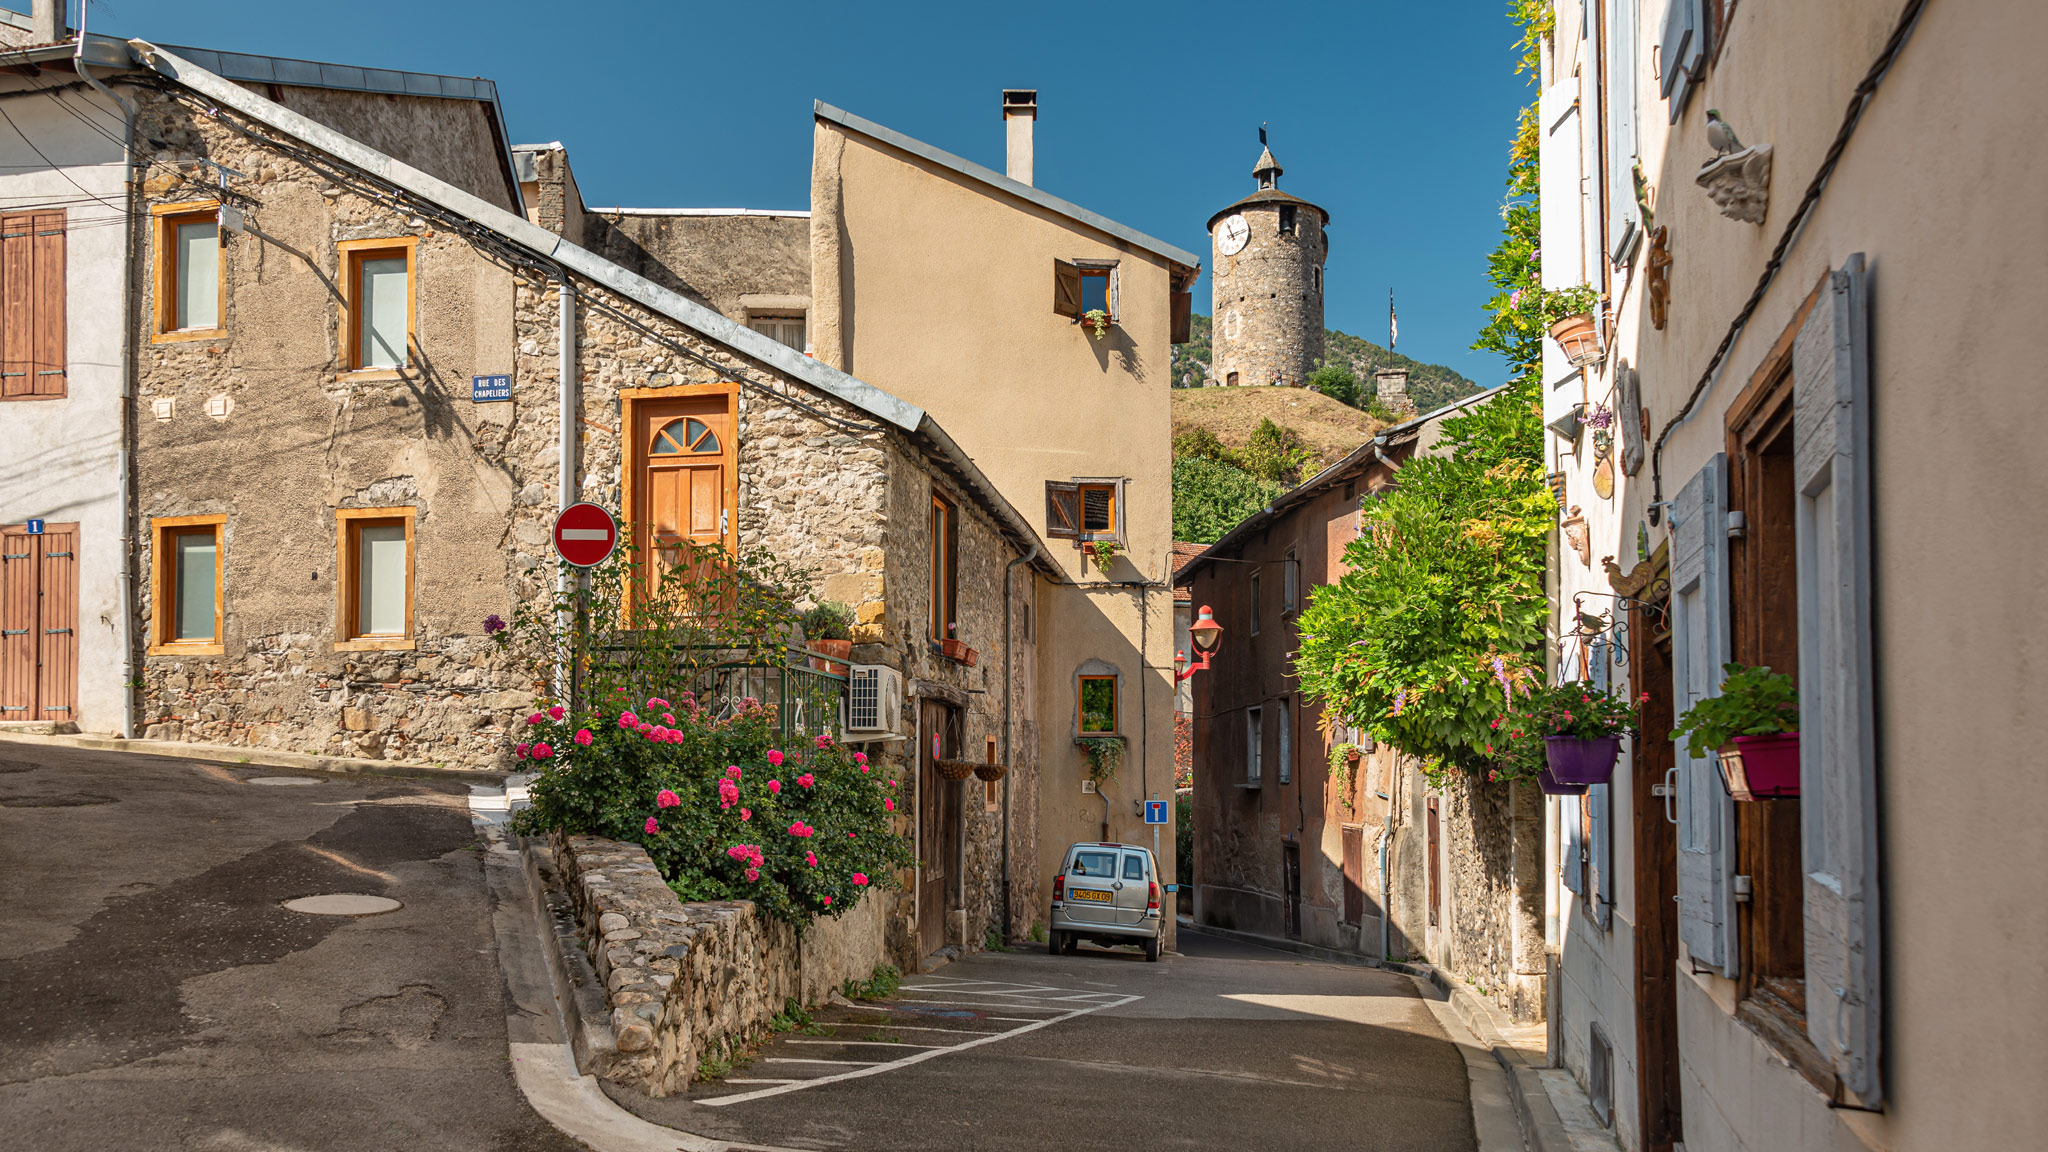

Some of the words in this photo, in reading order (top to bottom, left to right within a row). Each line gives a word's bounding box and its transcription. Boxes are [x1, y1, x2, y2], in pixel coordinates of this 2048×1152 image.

[478, 379, 490, 387] RUE
[494, 378, 506, 386] DES
[474, 389, 510, 398] CHAPELIERS
[32, 520, 38, 532] 1
